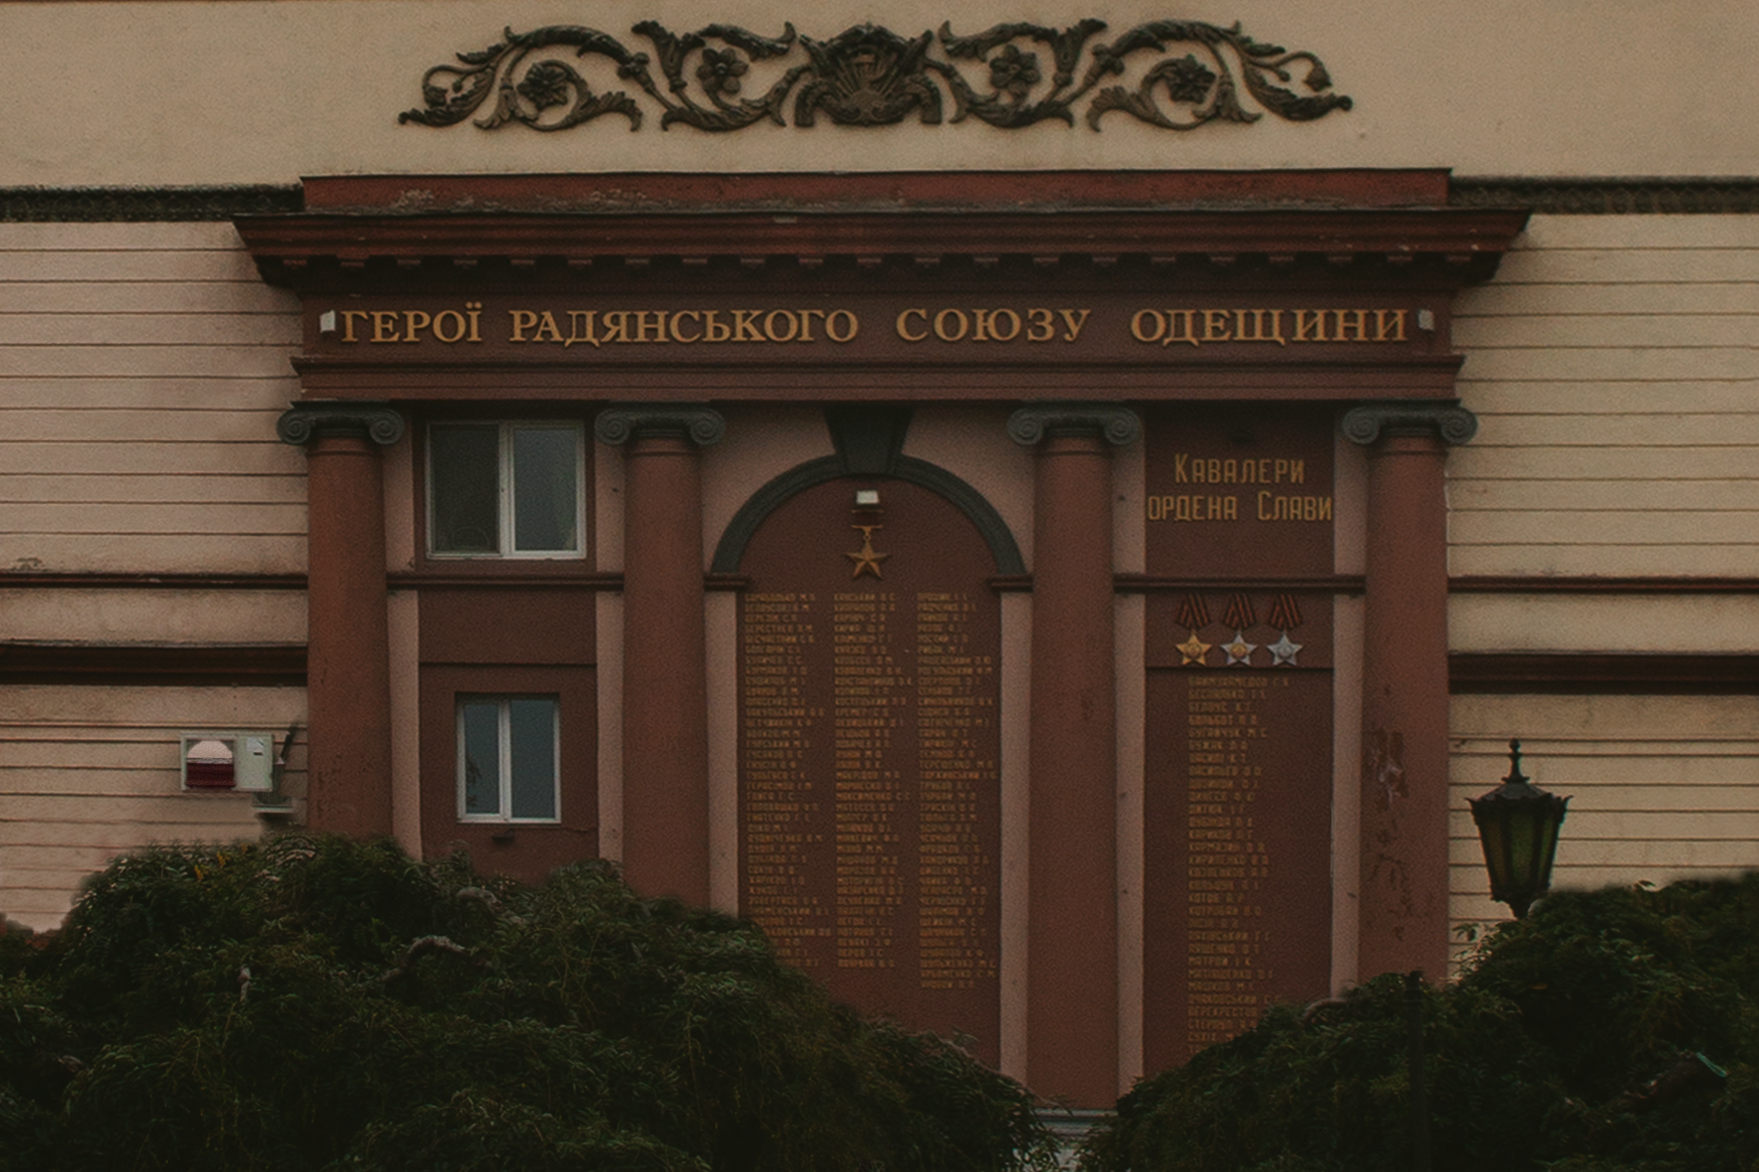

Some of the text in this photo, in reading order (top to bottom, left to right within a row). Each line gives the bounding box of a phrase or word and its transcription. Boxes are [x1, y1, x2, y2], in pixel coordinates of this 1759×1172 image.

[341, 301, 1408, 347] ГЕРОЇ РАДЯНСЬКОГО СОЮЗУ ОДЕЩИНИ
